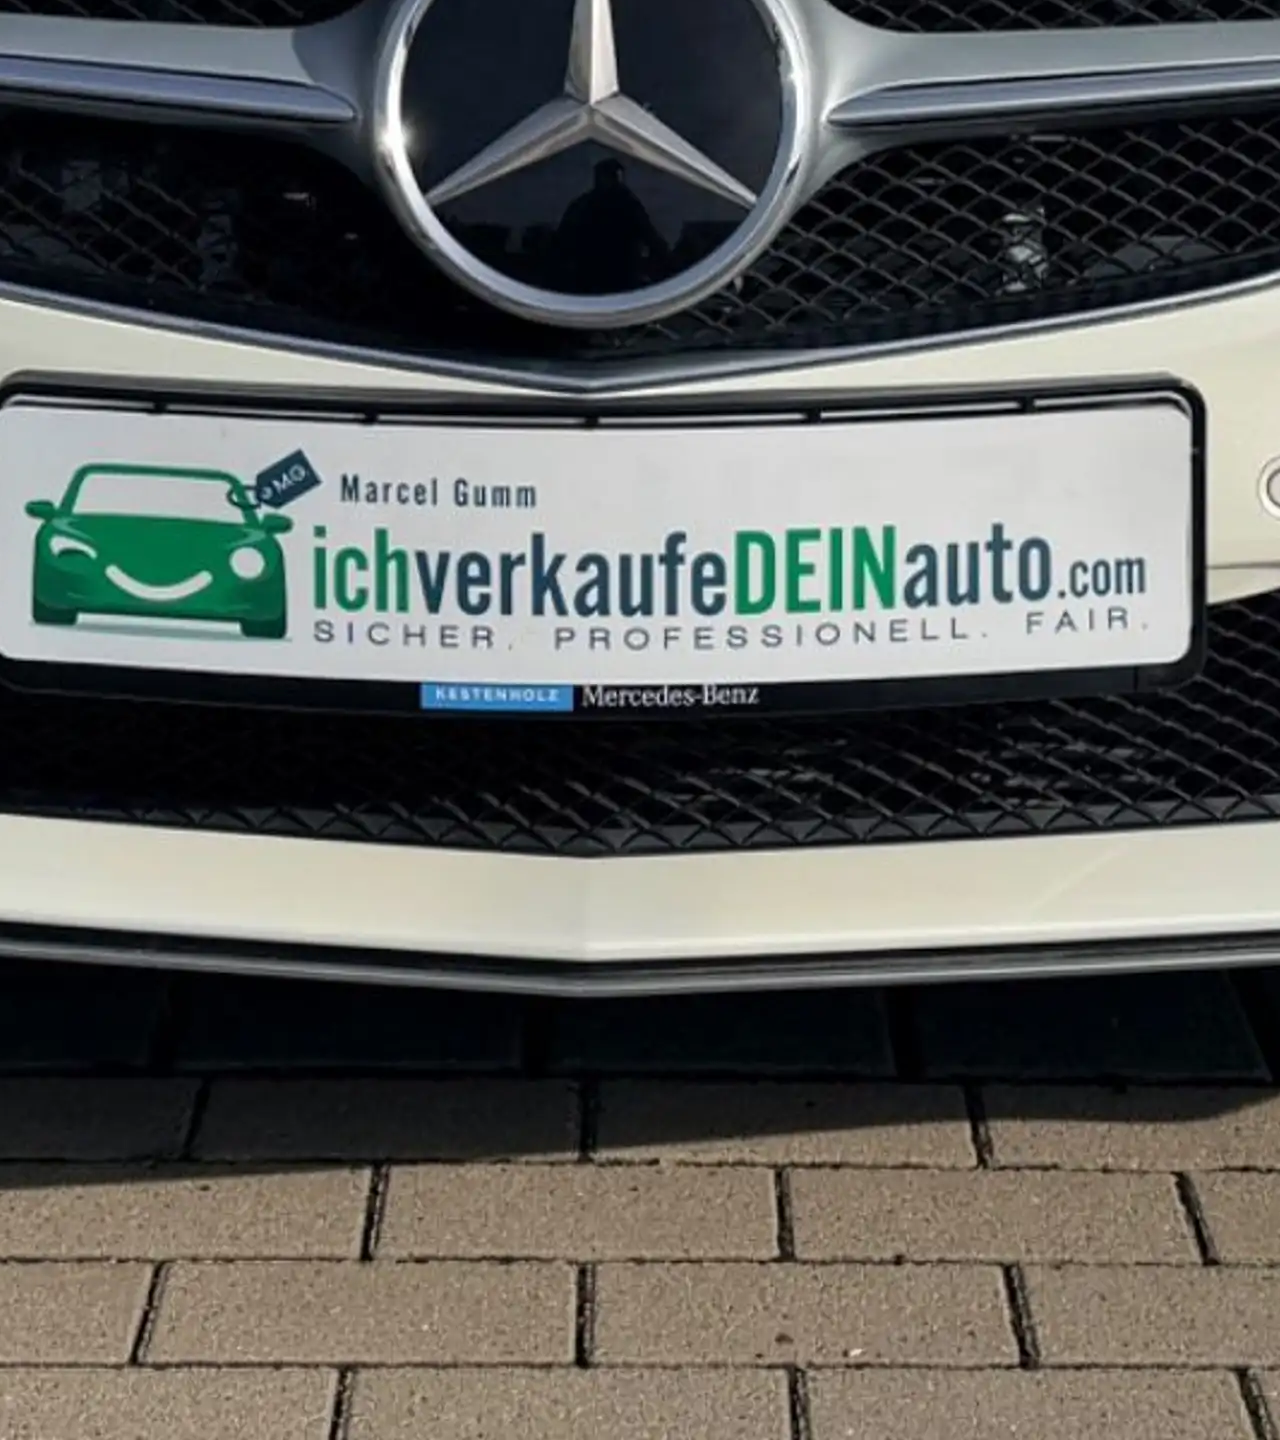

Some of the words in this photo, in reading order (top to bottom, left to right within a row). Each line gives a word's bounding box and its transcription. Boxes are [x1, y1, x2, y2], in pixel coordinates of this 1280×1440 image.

[340, 473, 438, 505] Marcel
[453, 477, 537, 508] Gumm
[313, 522, 1147, 618] ichverkaufeDEINauto.com
[313, 620, 514, 651] SICHER.
[554, 618, 988, 651] PROFESSIONELL.
[1025, 606, 1149, 635] FAIR.
[435, 685, 560, 702] KESTENHOLZ
[581, 683, 760, 707] Mercedes-Benz
